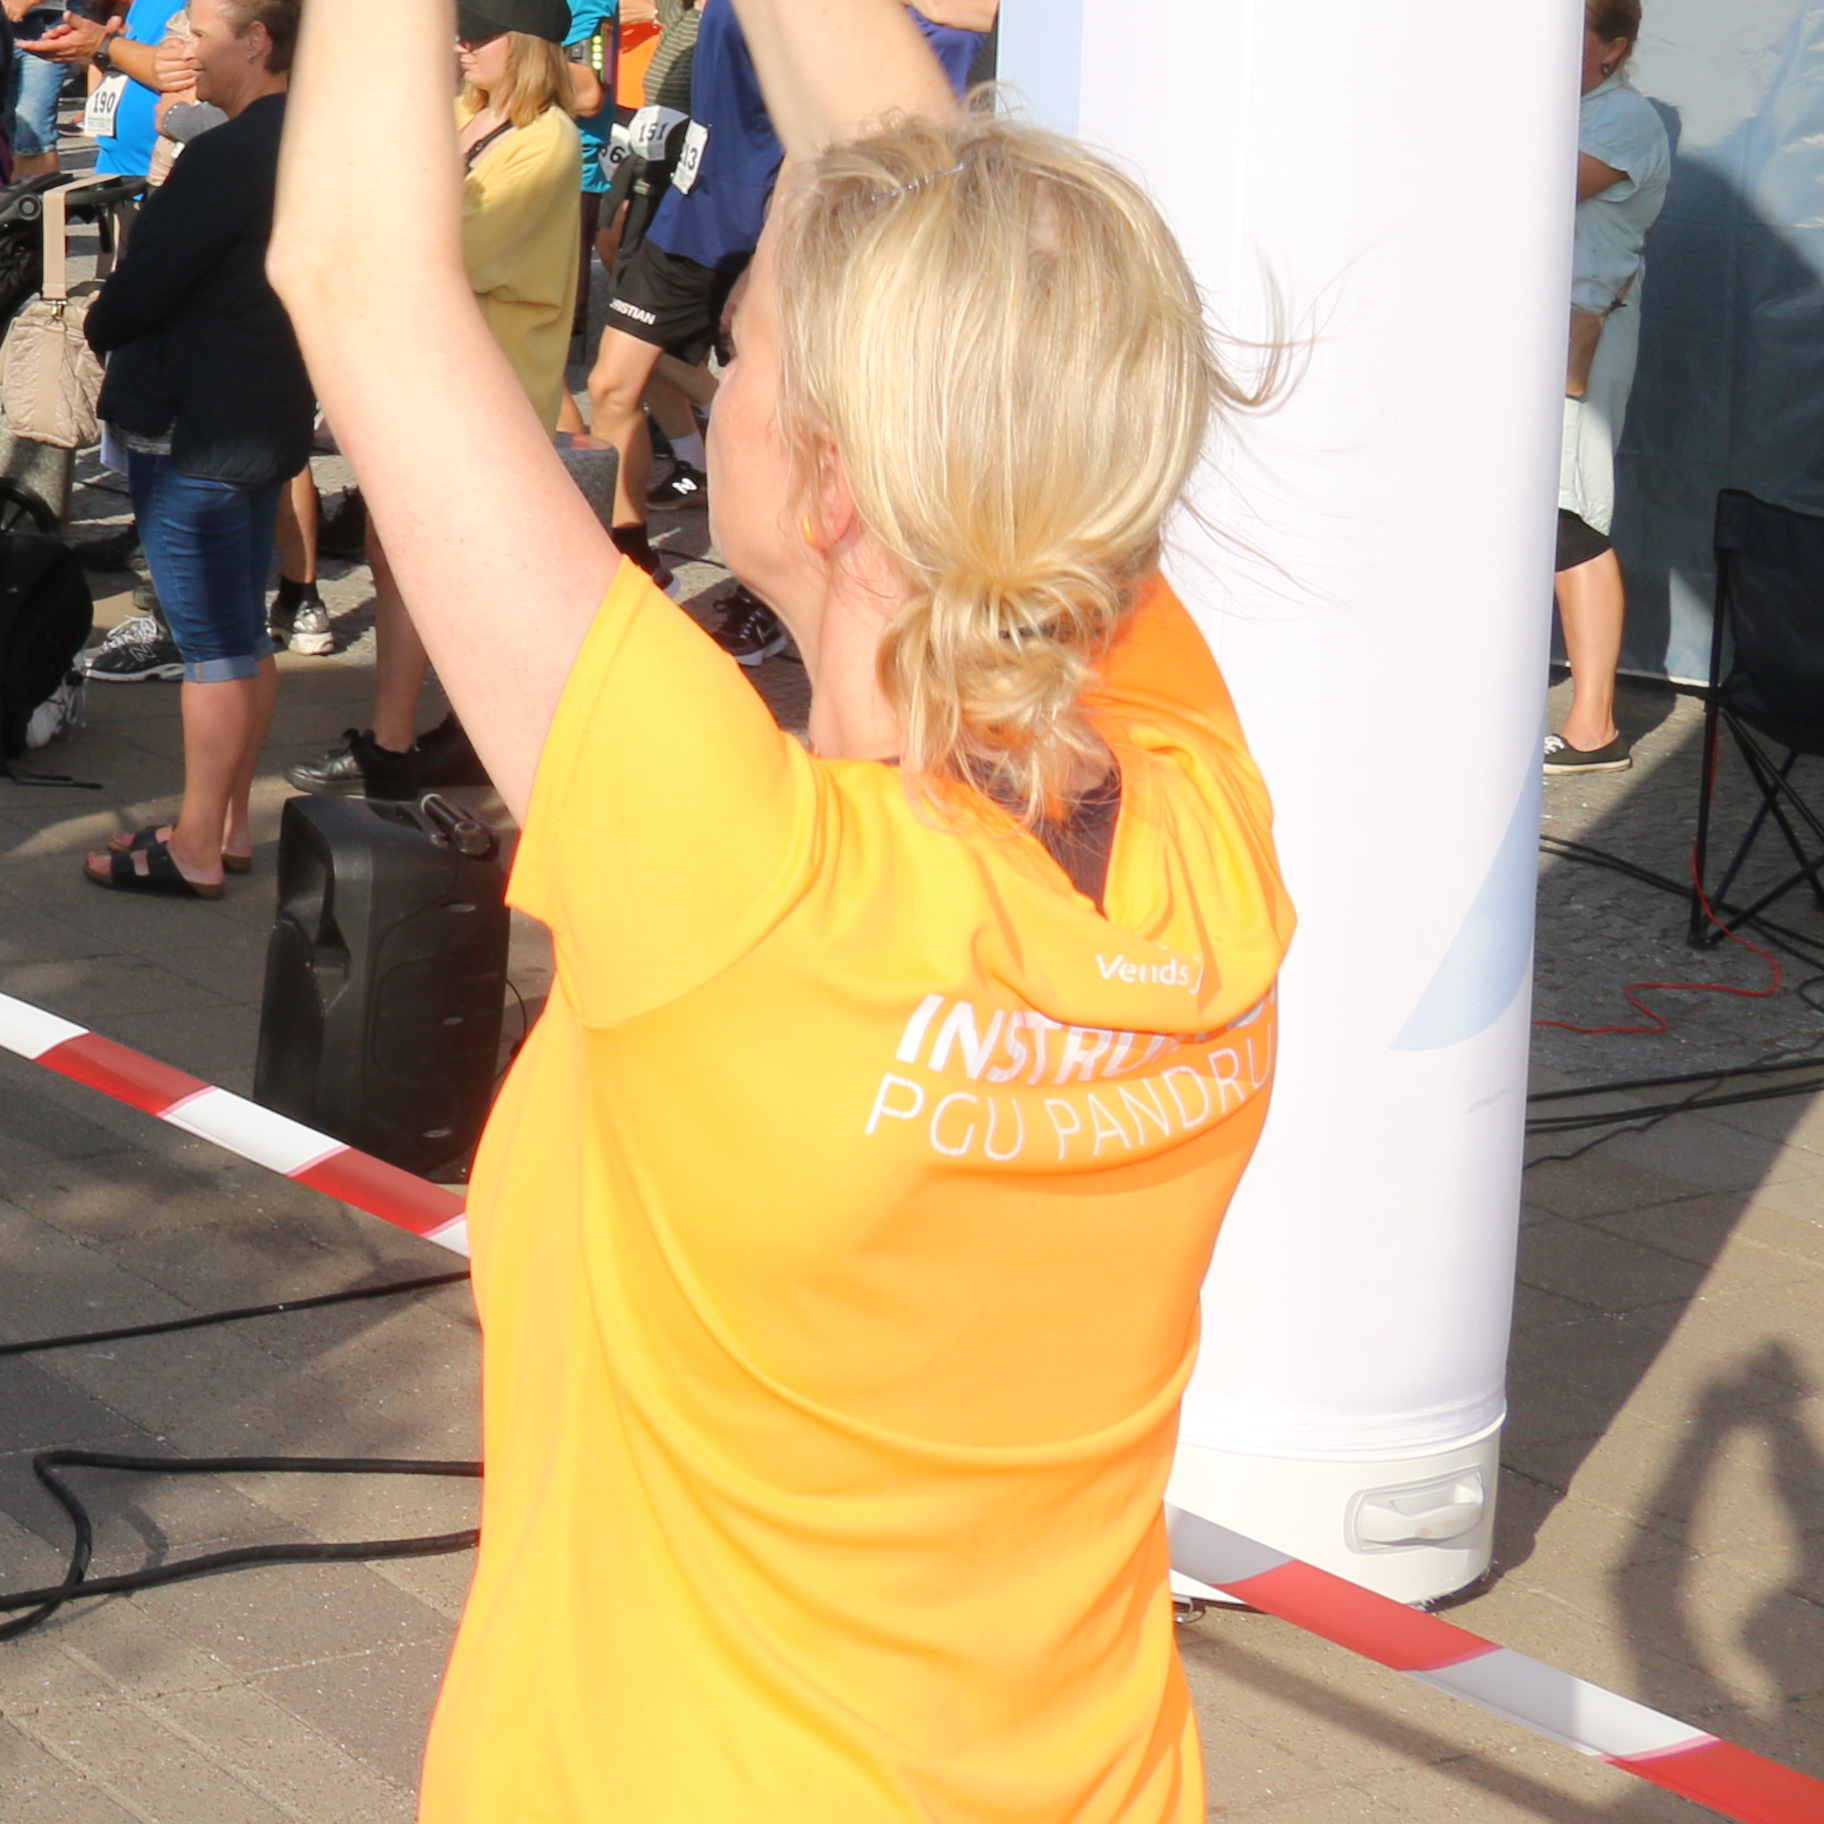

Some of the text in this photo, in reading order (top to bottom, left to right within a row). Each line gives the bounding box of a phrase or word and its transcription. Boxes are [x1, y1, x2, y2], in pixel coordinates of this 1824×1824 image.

[95, 90, 116, 115] 190
[638, 122, 669, 142] 151
[865, 1073, 1024, 1160] PGU
